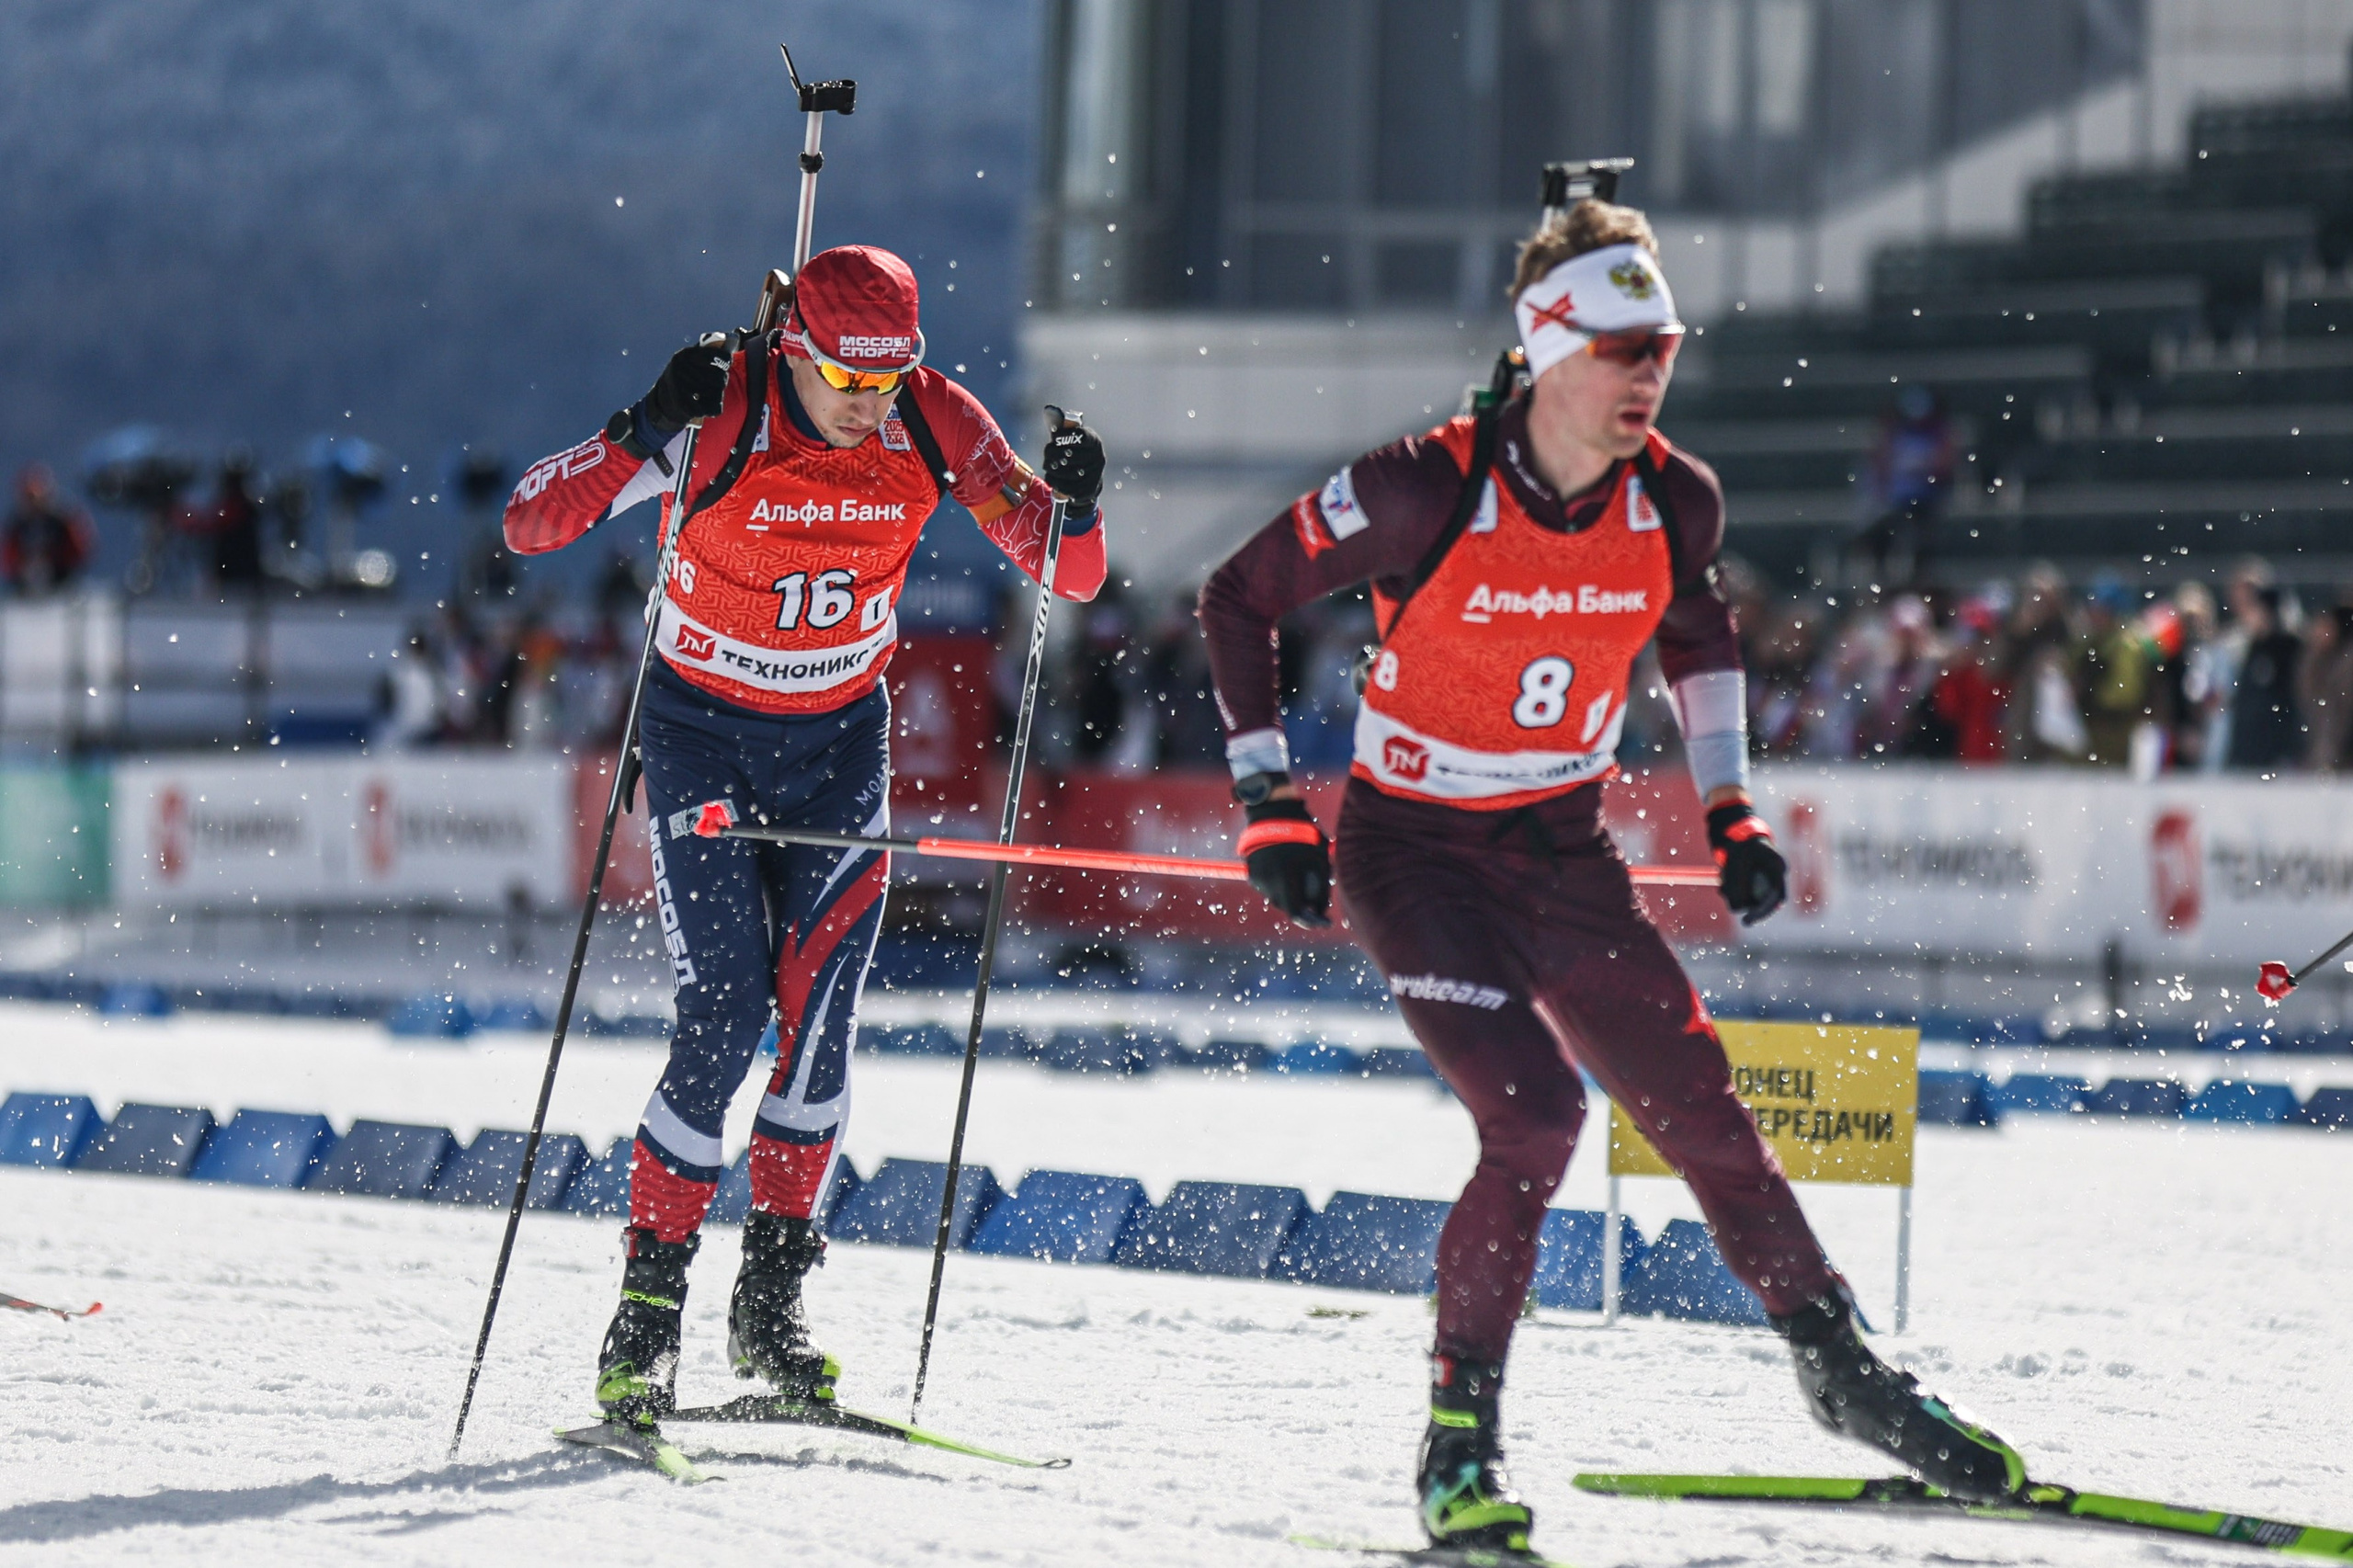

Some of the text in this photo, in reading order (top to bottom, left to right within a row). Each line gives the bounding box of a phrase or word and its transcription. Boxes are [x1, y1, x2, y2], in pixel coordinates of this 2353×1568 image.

[839, 335, 911, 347] МОСОБЛ
[839, 347, 900, 358] СПОРТ
[746, 498, 906, 531] Альфа Банк
[770, 568, 856, 631] 16
[1461, 583, 1648, 624] Альфа Банк
[1374, 650, 1399, 692] 8
[1512, 655, 1575, 729] 8
[1734, 1067, 1814, 1104] ОНЕЦ
[1756, 1107, 1894, 1145] ЕРЕДАЧИ
[621, 1290, 676, 1308] SCHER
